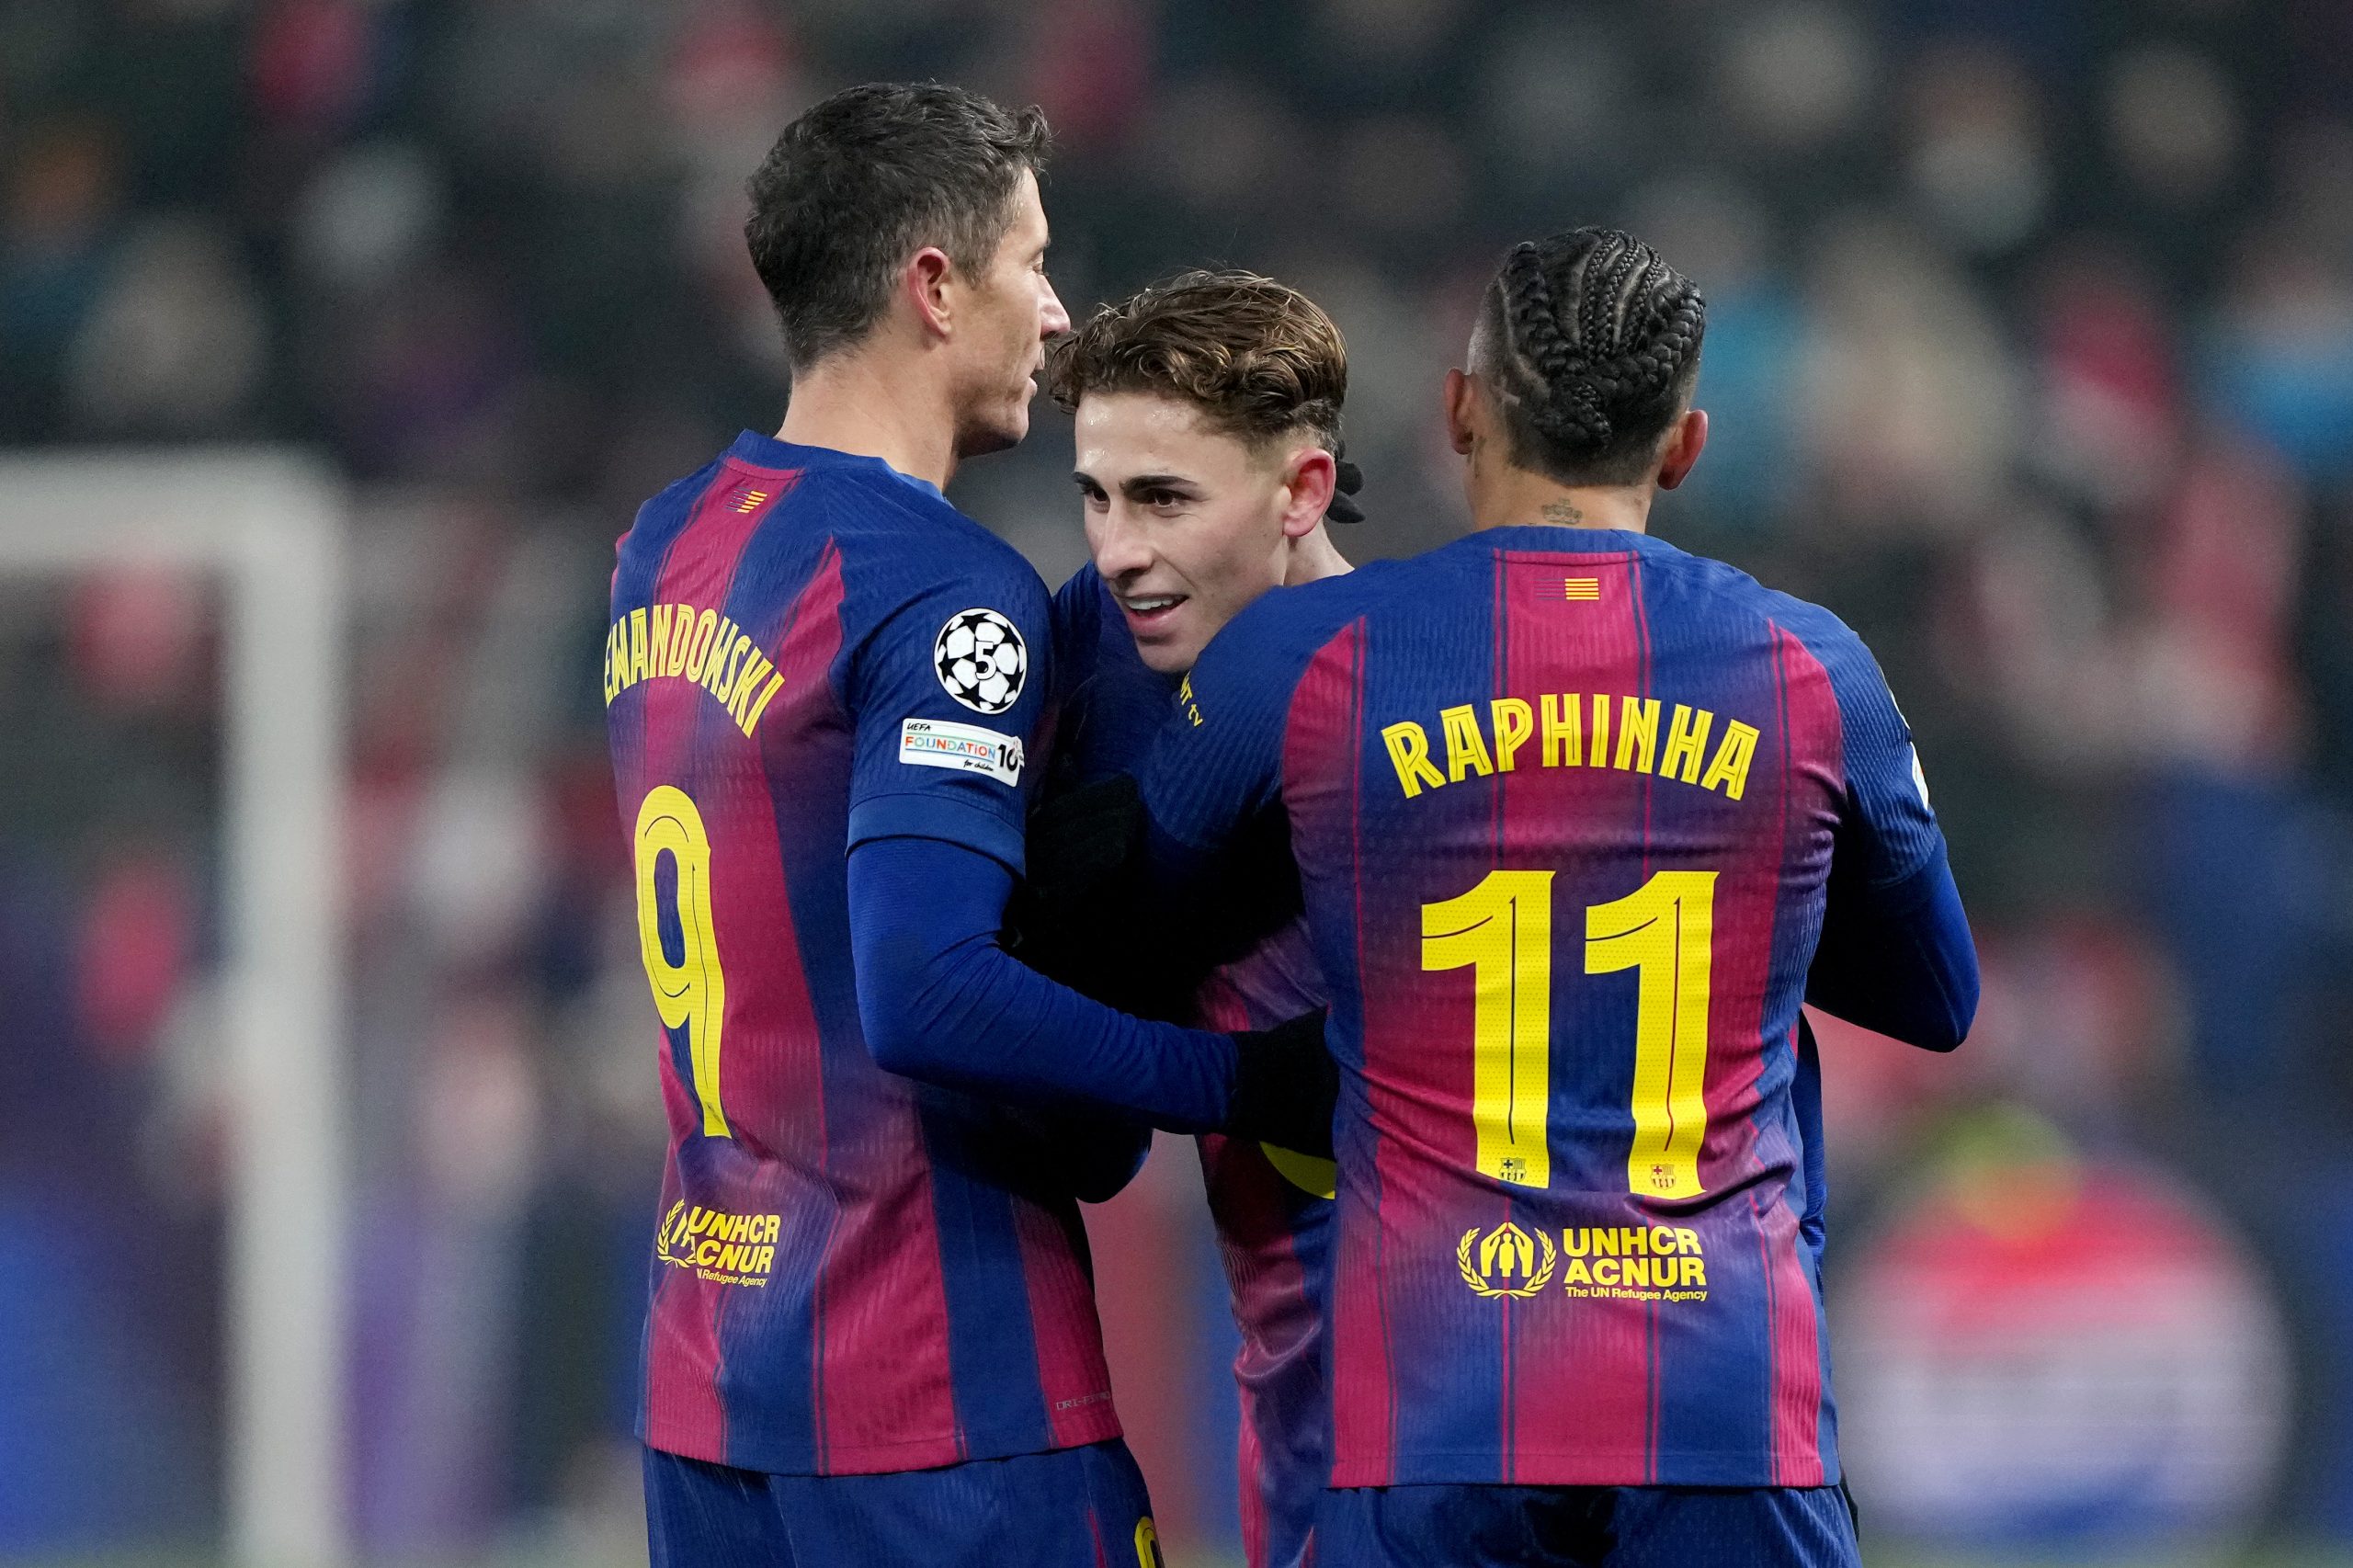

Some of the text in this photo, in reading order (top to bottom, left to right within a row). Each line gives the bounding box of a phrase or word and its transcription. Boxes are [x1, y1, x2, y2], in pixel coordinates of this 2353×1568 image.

[605, 604, 785, 739] EWANDOWSKI
[975, 642, 997, 680] 5
[906, 722, 931, 732] UEFA
[963, 759, 995, 772] for children
[1381, 693, 1760, 801] RAPHINHA
[634, 784, 732, 1139] 9
[1421, 869, 1720, 1199] 11
[688, 1206, 780, 1244] UNHCR
[1563, 1225, 1703, 1257] UNHCR
[691, 1236, 775, 1274] CNUR
[1563, 1257, 1707, 1287] ACNUR
[702, 1269, 739, 1284] Refugee
[738, 1275, 767, 1288] Agency
[1565, 1287, 1707, 1302] The UN Refugee Agency
